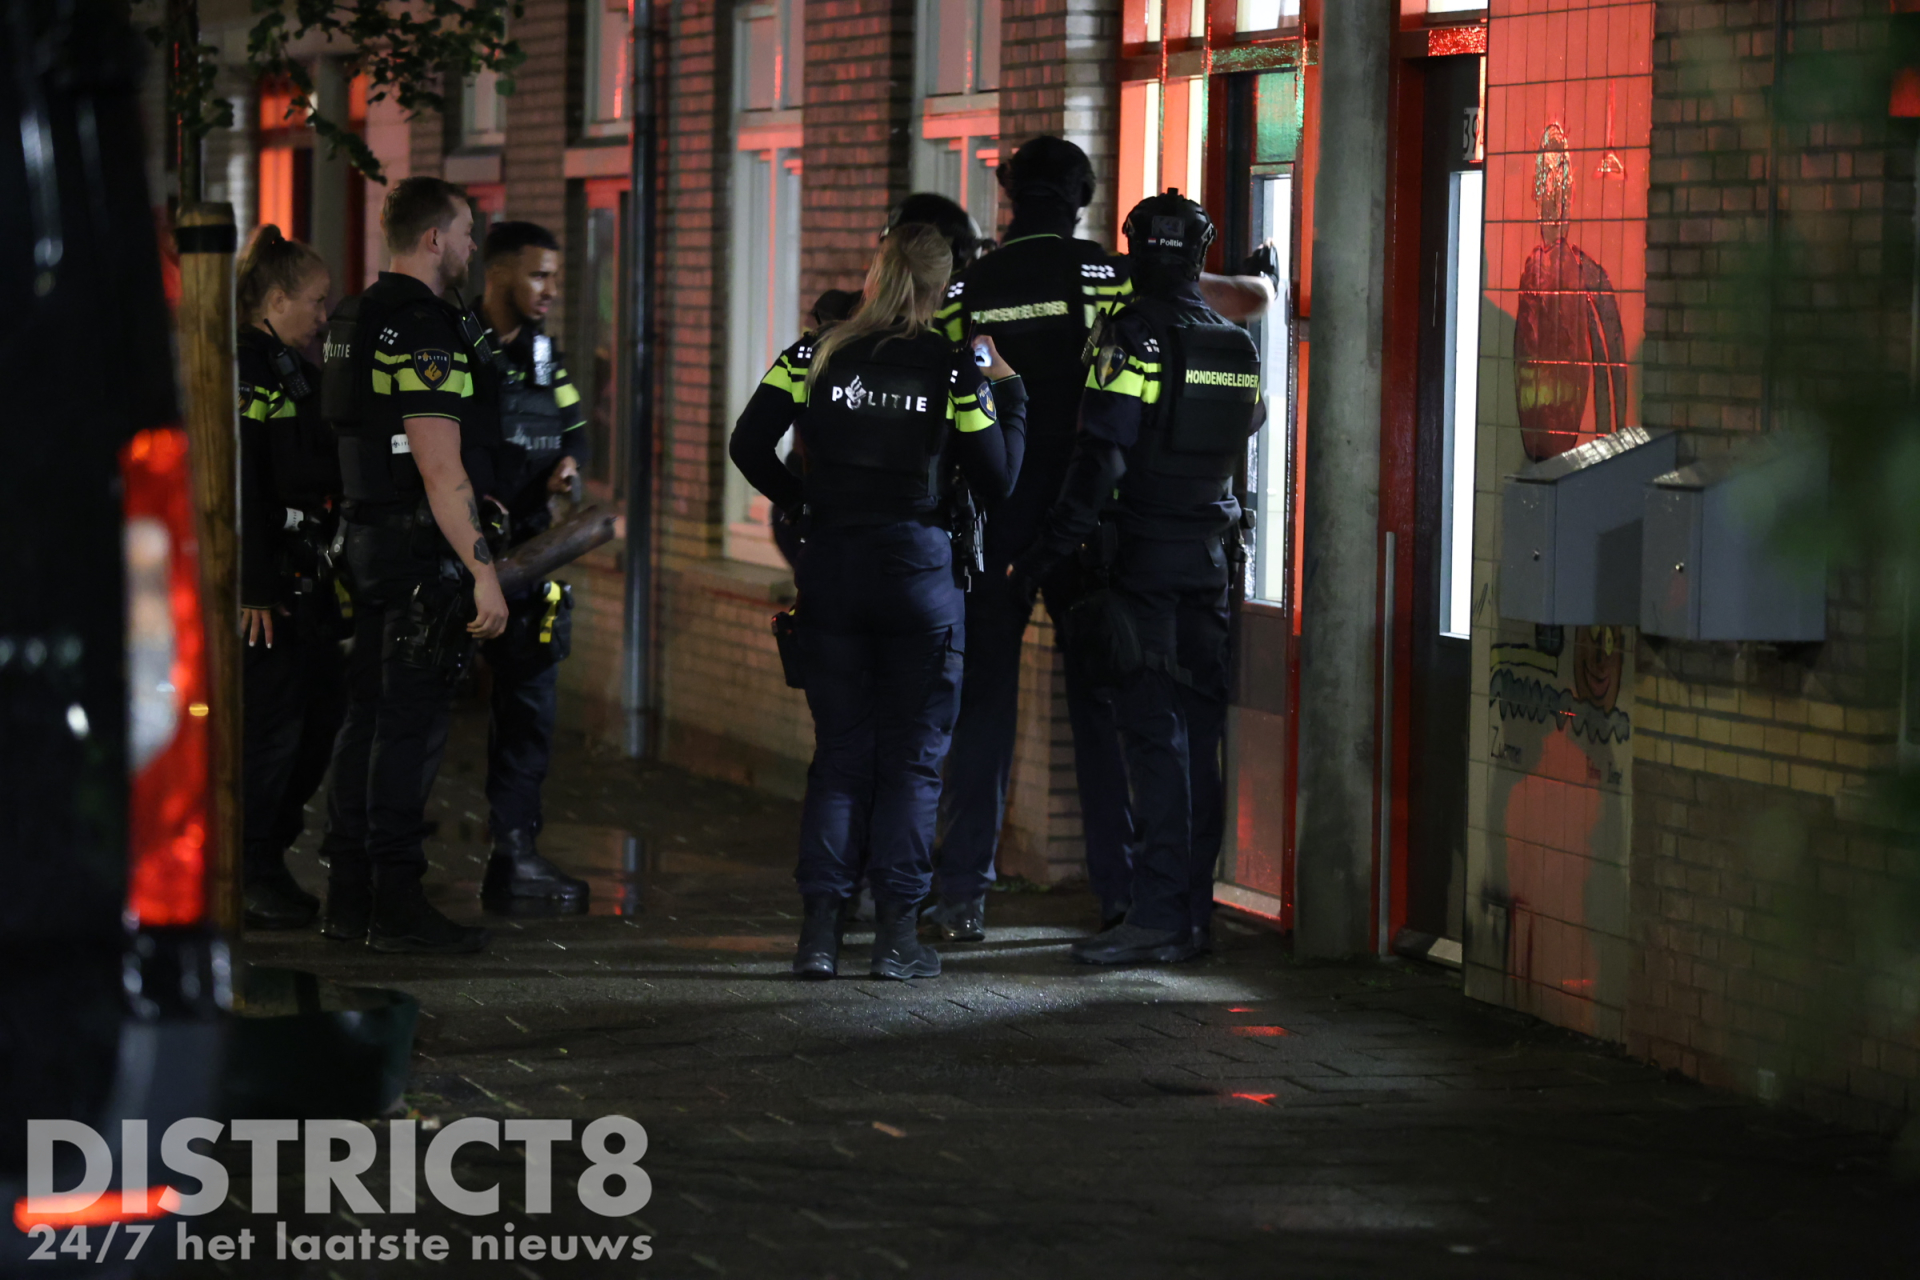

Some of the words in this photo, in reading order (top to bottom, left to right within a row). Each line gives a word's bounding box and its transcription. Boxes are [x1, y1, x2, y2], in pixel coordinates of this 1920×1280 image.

[1160, 238, 1183, 248] Politie
[417, 354, 447, 362] POLITIE
[1185, 369, 1259, 389] HONDENGELEIDER
[831, 382, 928, 412] POLITIE
[505, 430, 562, 450] LITIE
